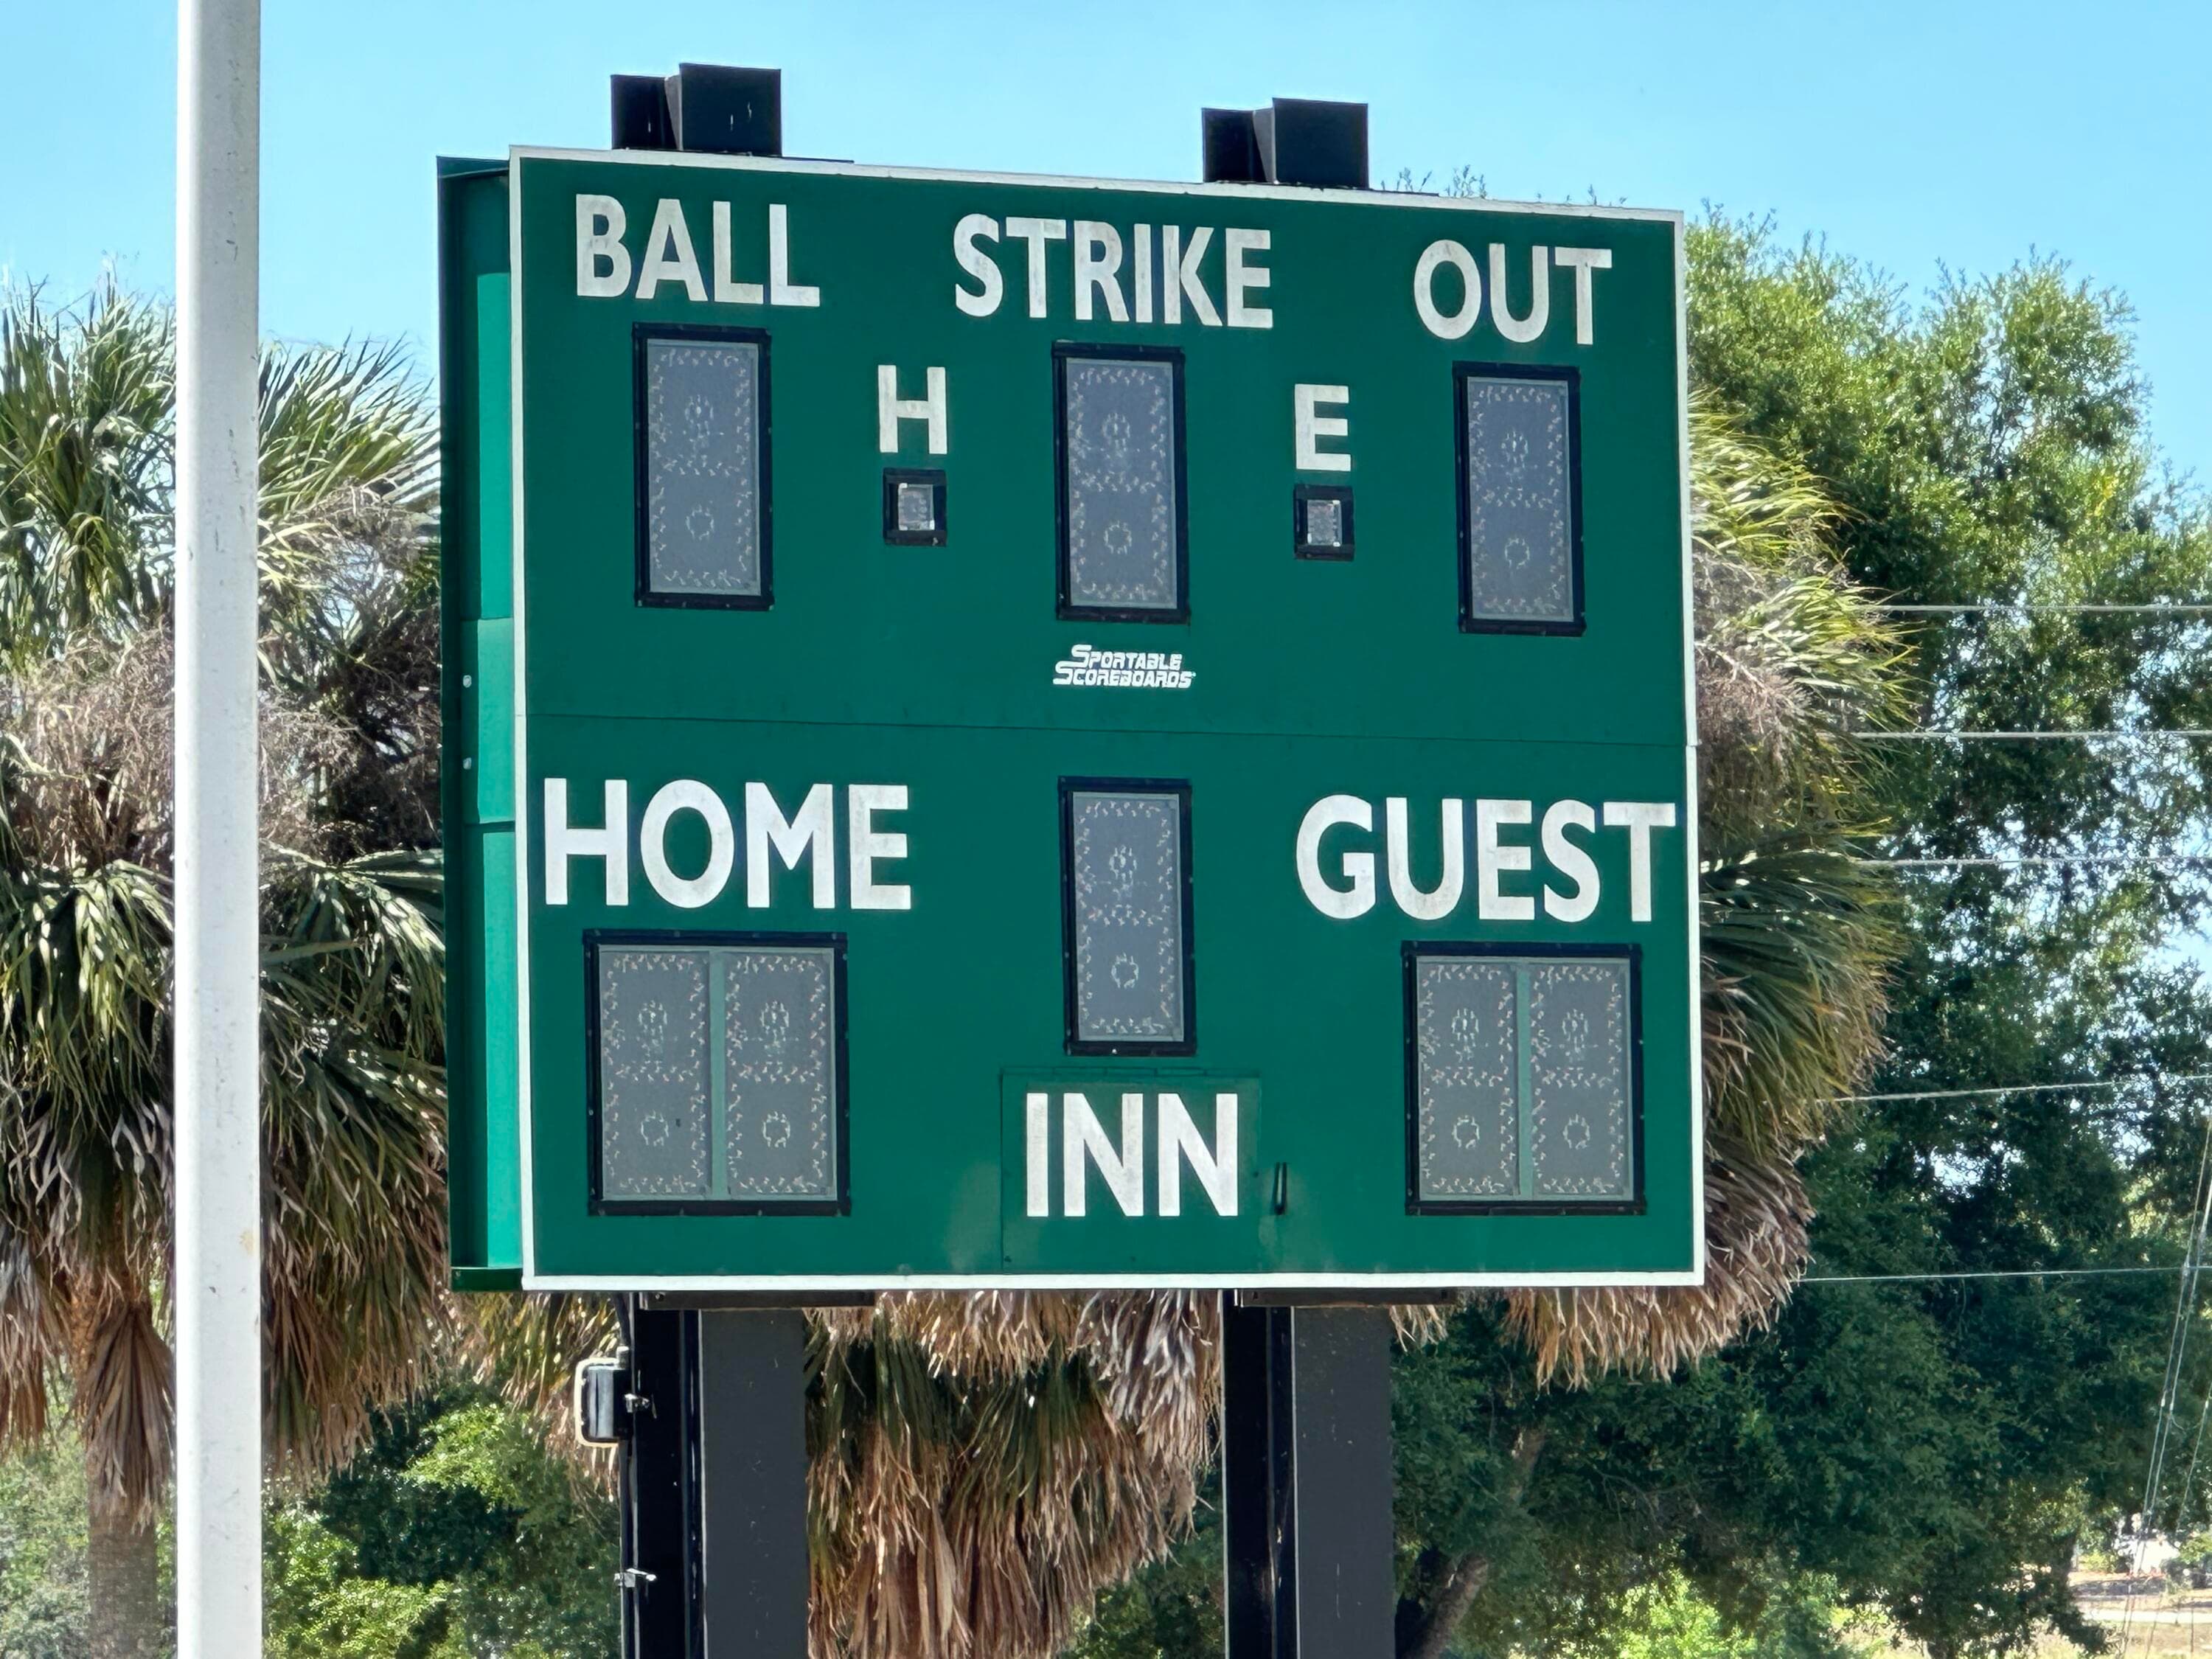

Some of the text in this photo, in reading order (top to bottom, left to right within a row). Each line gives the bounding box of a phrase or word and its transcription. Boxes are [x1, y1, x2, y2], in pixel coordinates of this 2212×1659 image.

[574, 192, 821, 307] BALL
[953, 213, 1273, 329] STRIKE
[1413, 239, 1613, 346] OUT
[877, 364, 948, 455] H
[1294, 383, 1352, 472] E
[1052, 661, 1194, 689] SCOREBOARDS
[1071, 644, 1183, 670] SPORTABLE
[543, 777, 914, 911] HOME
[1295, 793, 1677, 922] GUEST
[1026, 1092, 1239, 1218] INN
